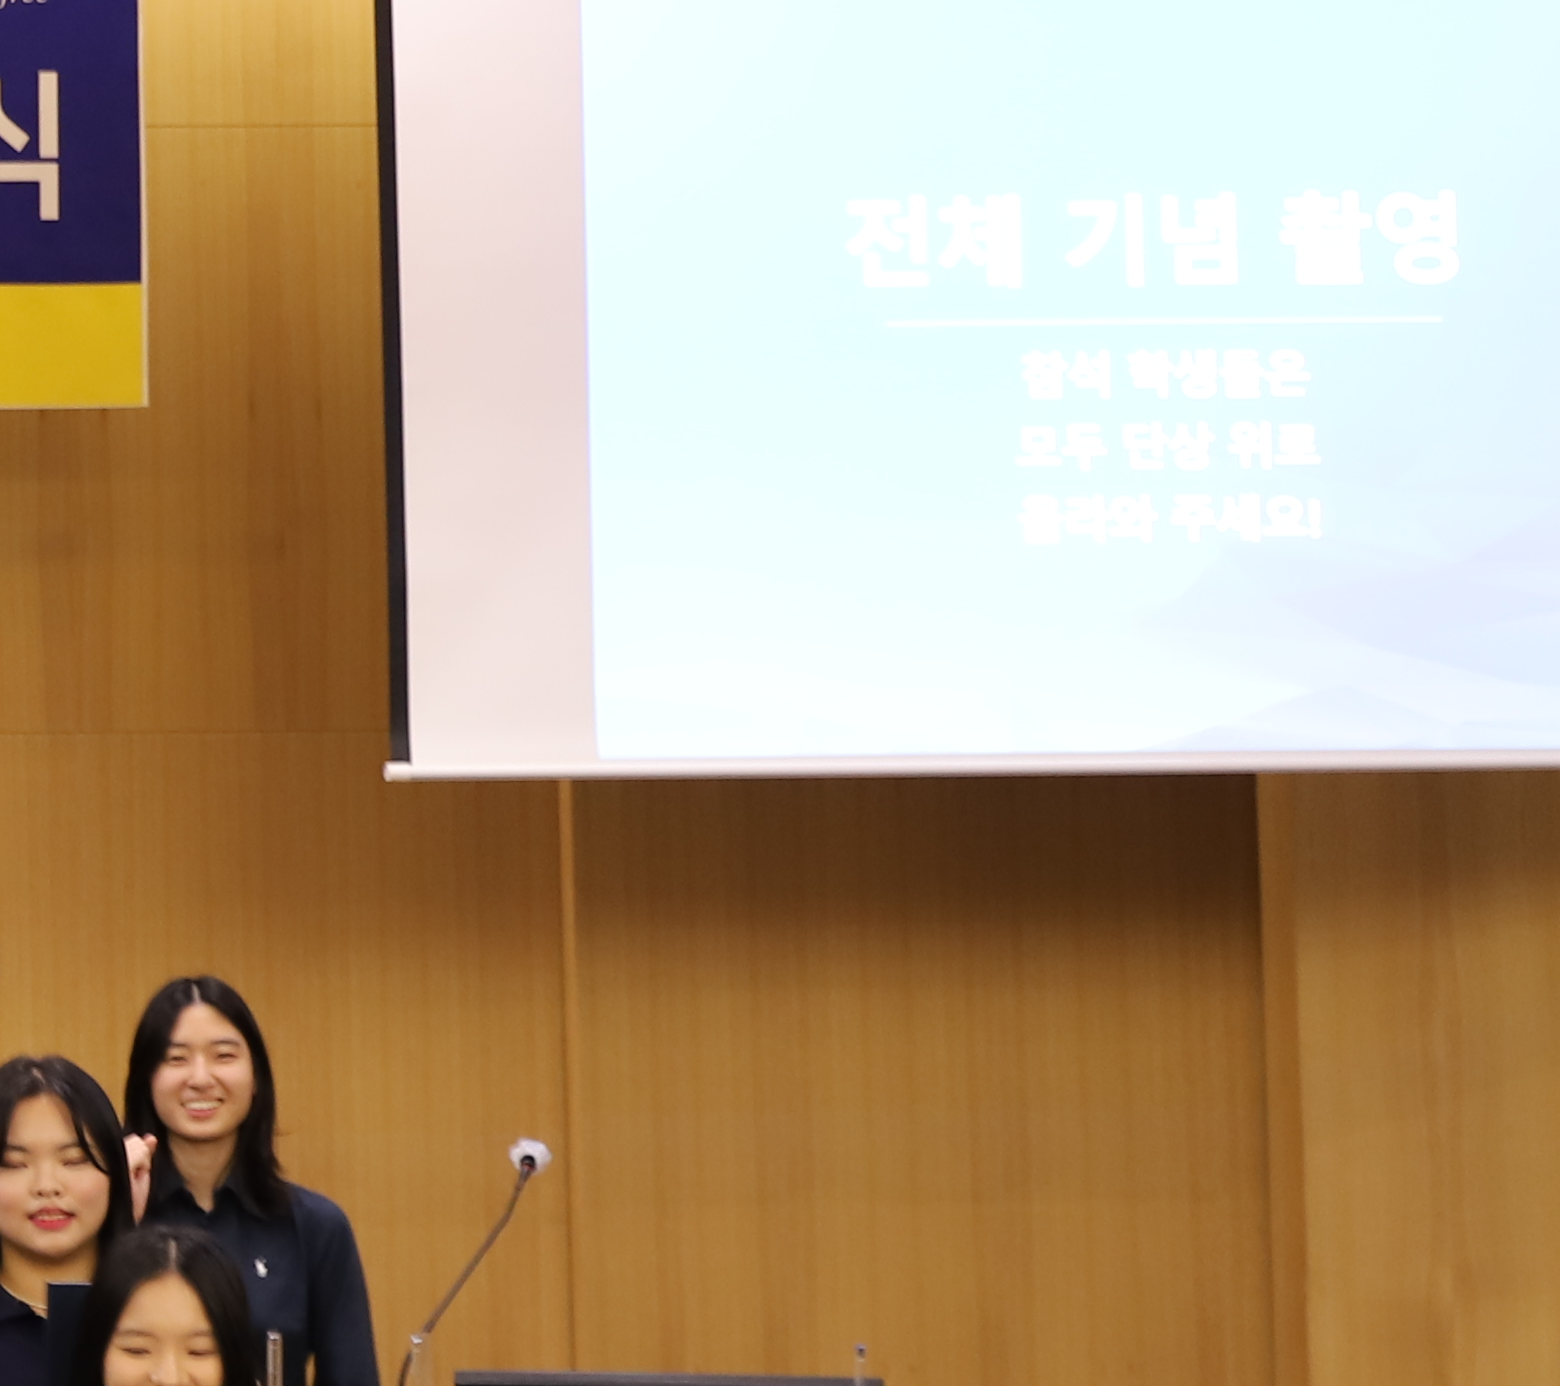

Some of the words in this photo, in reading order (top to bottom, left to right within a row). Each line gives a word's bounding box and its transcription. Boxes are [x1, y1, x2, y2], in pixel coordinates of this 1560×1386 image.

[844, 192, 1023, 289] 전체
[1064, 190, 1239, 289] 기념
[1278, 187, 1461, 287] 촬영
[1014, 421, 1108, 472] 모두
[1122, 419, 1215, 472] 단상
[1227, 419, 1321, 470] 위로
[1169, 490, 1322, 544] 주세요!
